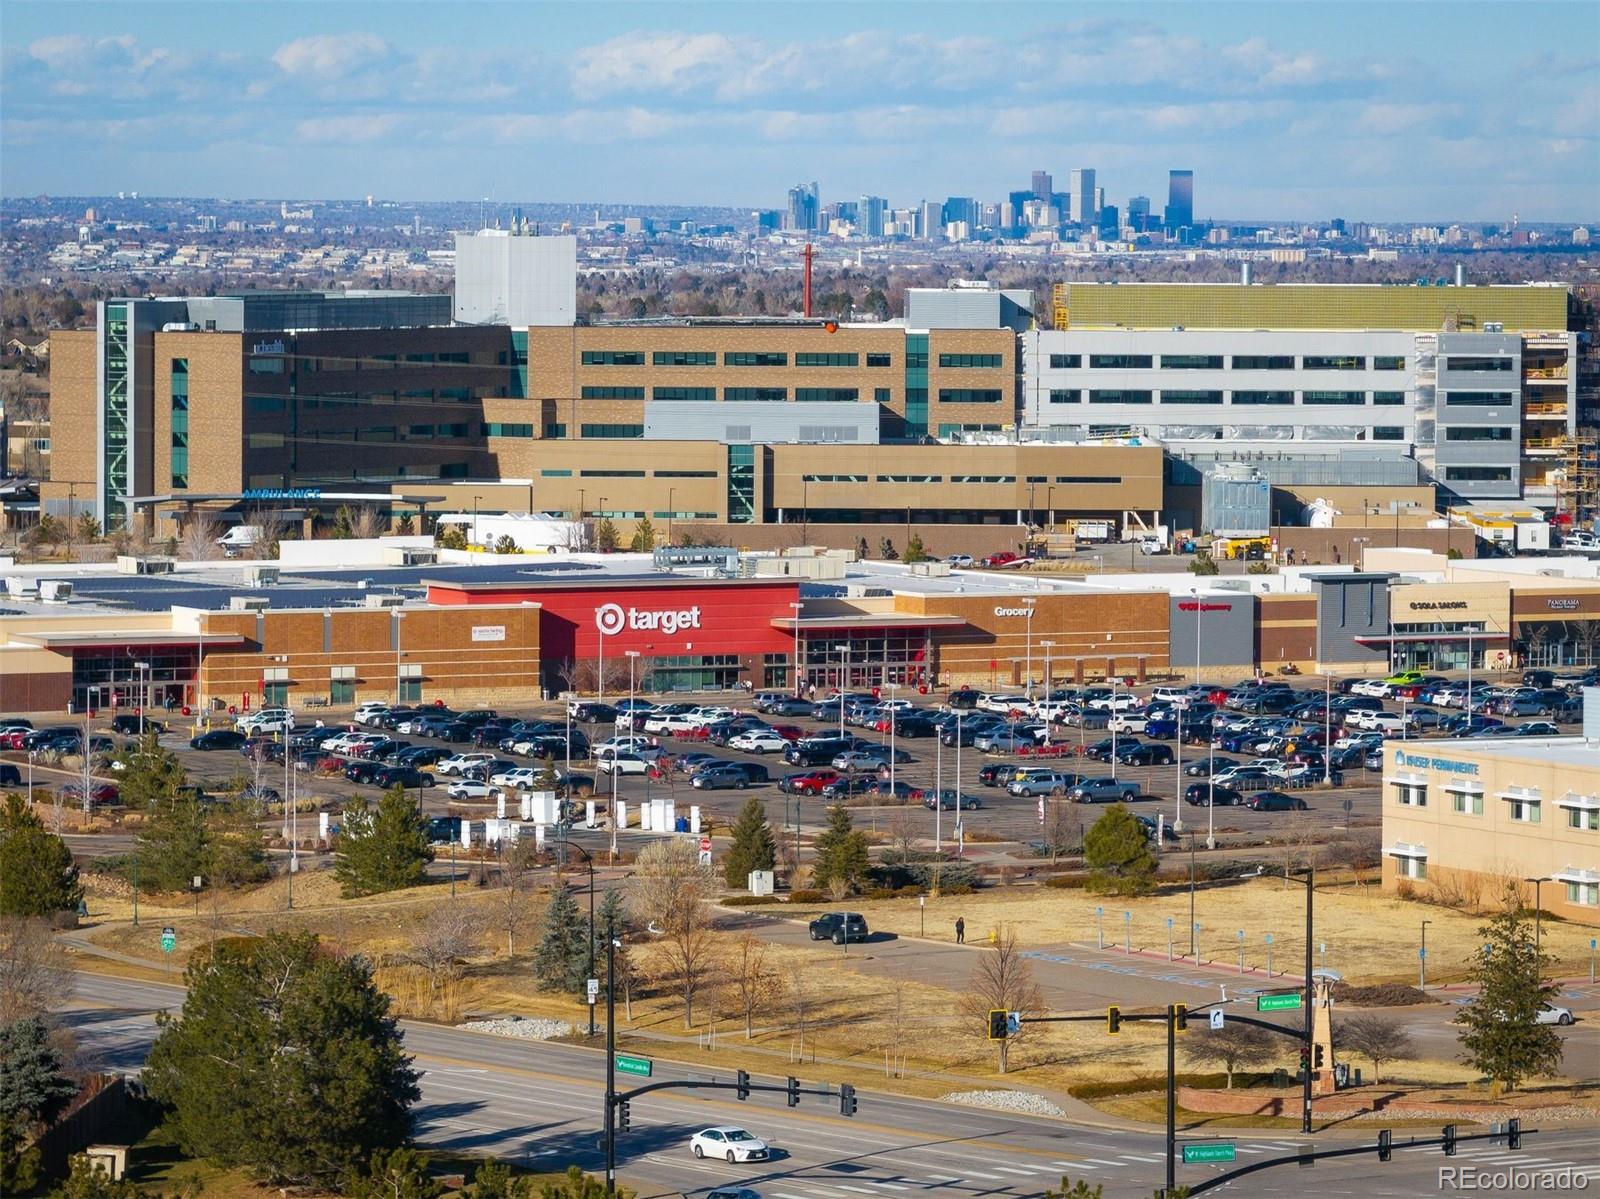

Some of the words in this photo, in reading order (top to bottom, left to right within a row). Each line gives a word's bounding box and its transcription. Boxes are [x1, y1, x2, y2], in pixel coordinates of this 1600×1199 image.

[243, 488, 321, 499] AMBULANCE
[994, 606, 1035, 618] Grocery
[628, 606, 700, 634] target
